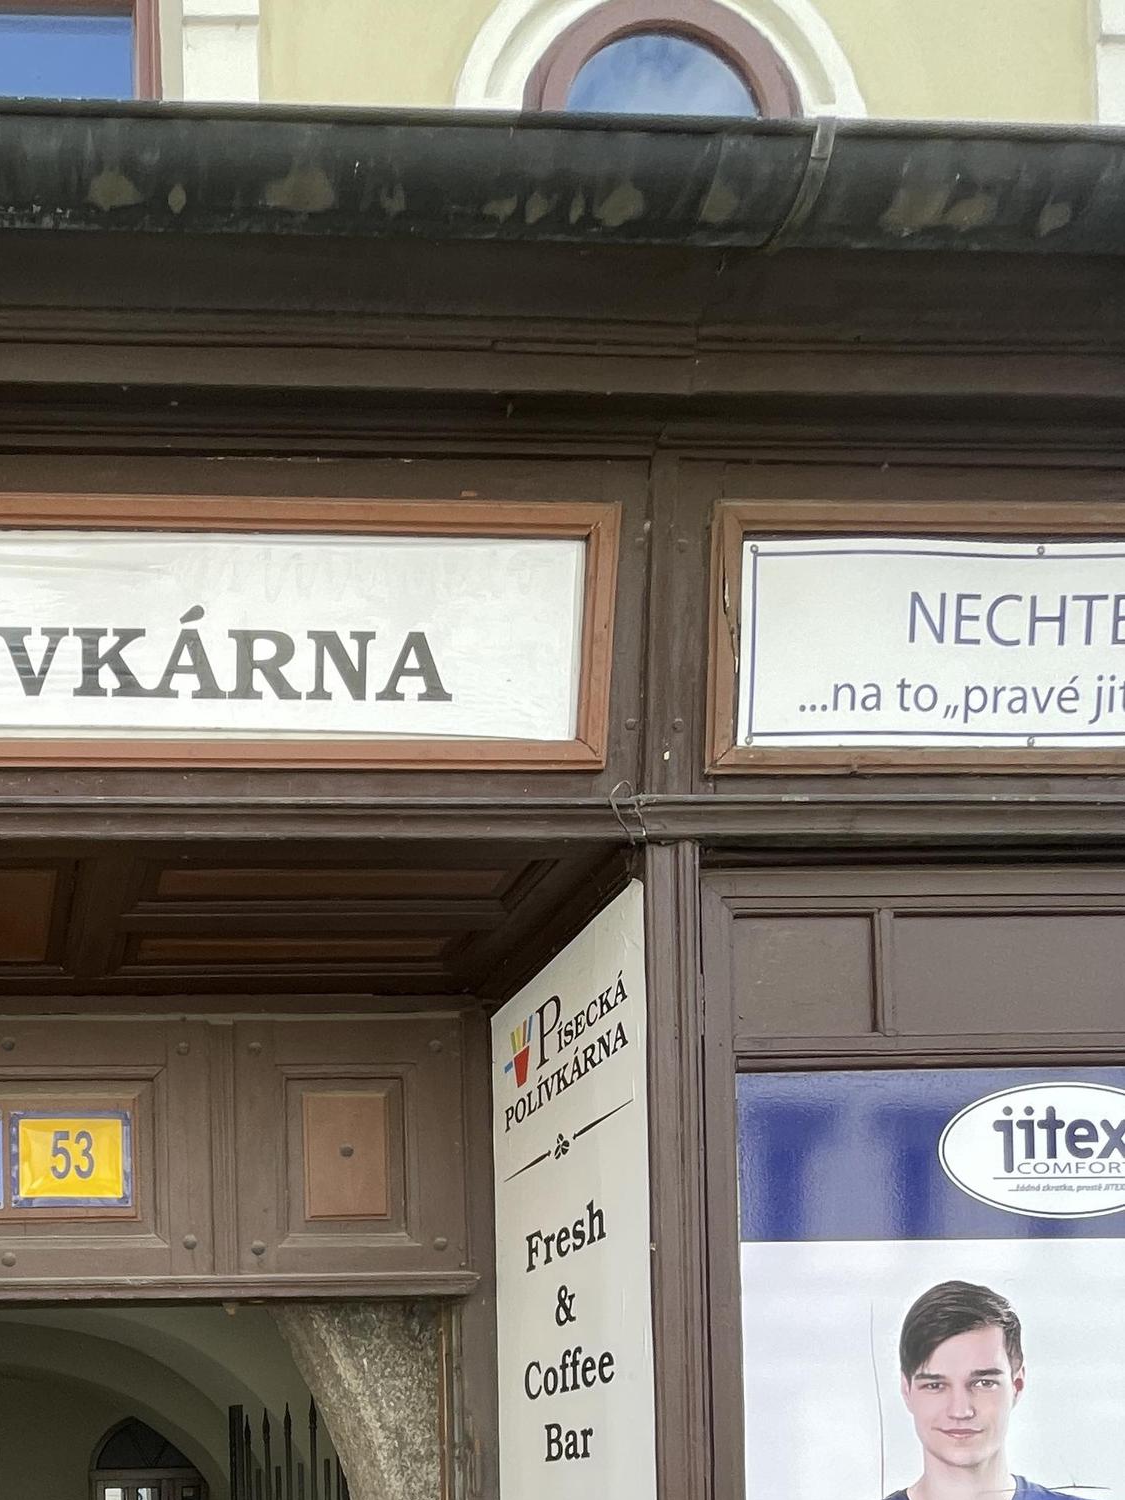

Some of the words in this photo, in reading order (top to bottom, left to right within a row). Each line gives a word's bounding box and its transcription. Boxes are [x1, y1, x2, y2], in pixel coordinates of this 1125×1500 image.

[504, 1021, 629, 1134] POLÍVKÁRNA
[50, 1130, 95, 1180] 53
[1017, 1161, 1125, 1175] COMFOR
[525, 1198, 607, 1274] Fresh
[554, 1284, 576, 1327] &
[524, 1345, 615, 1401] Coffee
[544, 1421, 593, 1463] Bar
